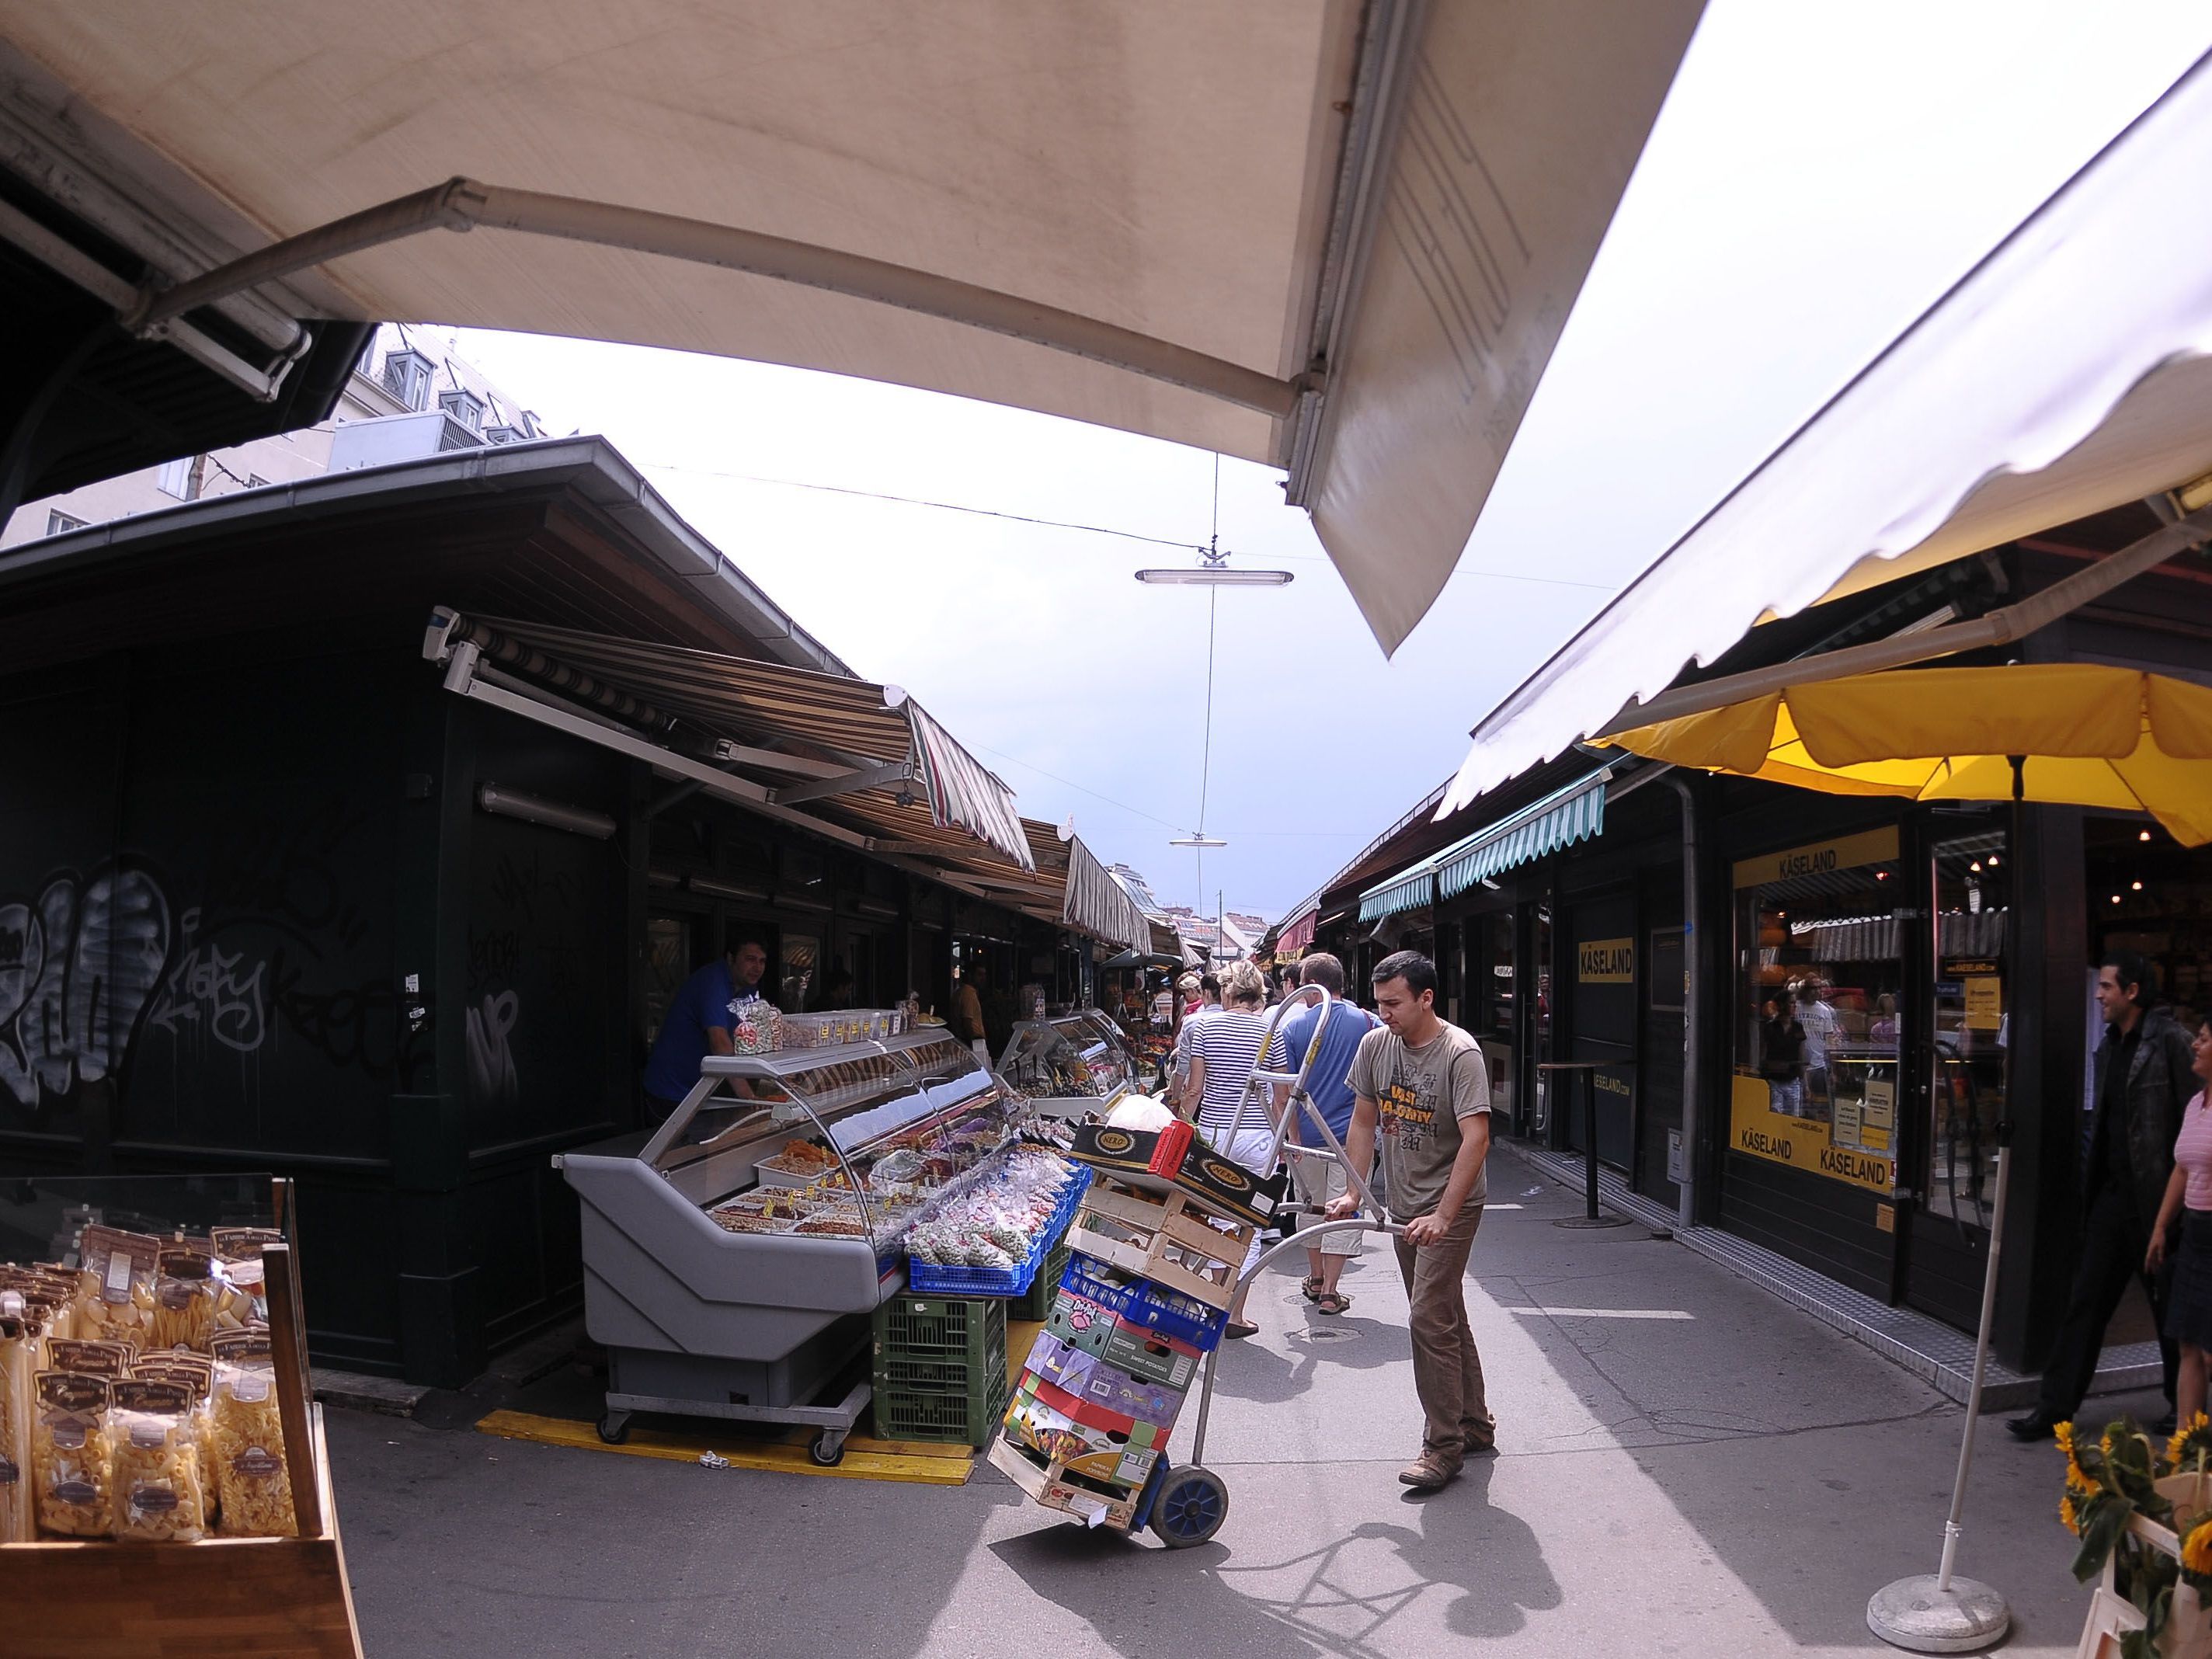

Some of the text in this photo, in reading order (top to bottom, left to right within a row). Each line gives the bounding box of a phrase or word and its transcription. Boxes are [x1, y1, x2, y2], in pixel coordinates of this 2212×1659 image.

[1779, 849, 1836, 878] KÄSELAND
[1580, 944, 1633, 975] KÄSELAND
[1390, 1085, 1417, 1104] VAST
[1103, 1136, 1124, 1146] NERO
[1167, 1134, 1187, 1170] Premium
[1741, 1126, 1792, 1160] KÄSELAND
[1212, 1166, 1238, 1182] NERO
[1820, 1146, 1886, 1185] KÄSELAND
